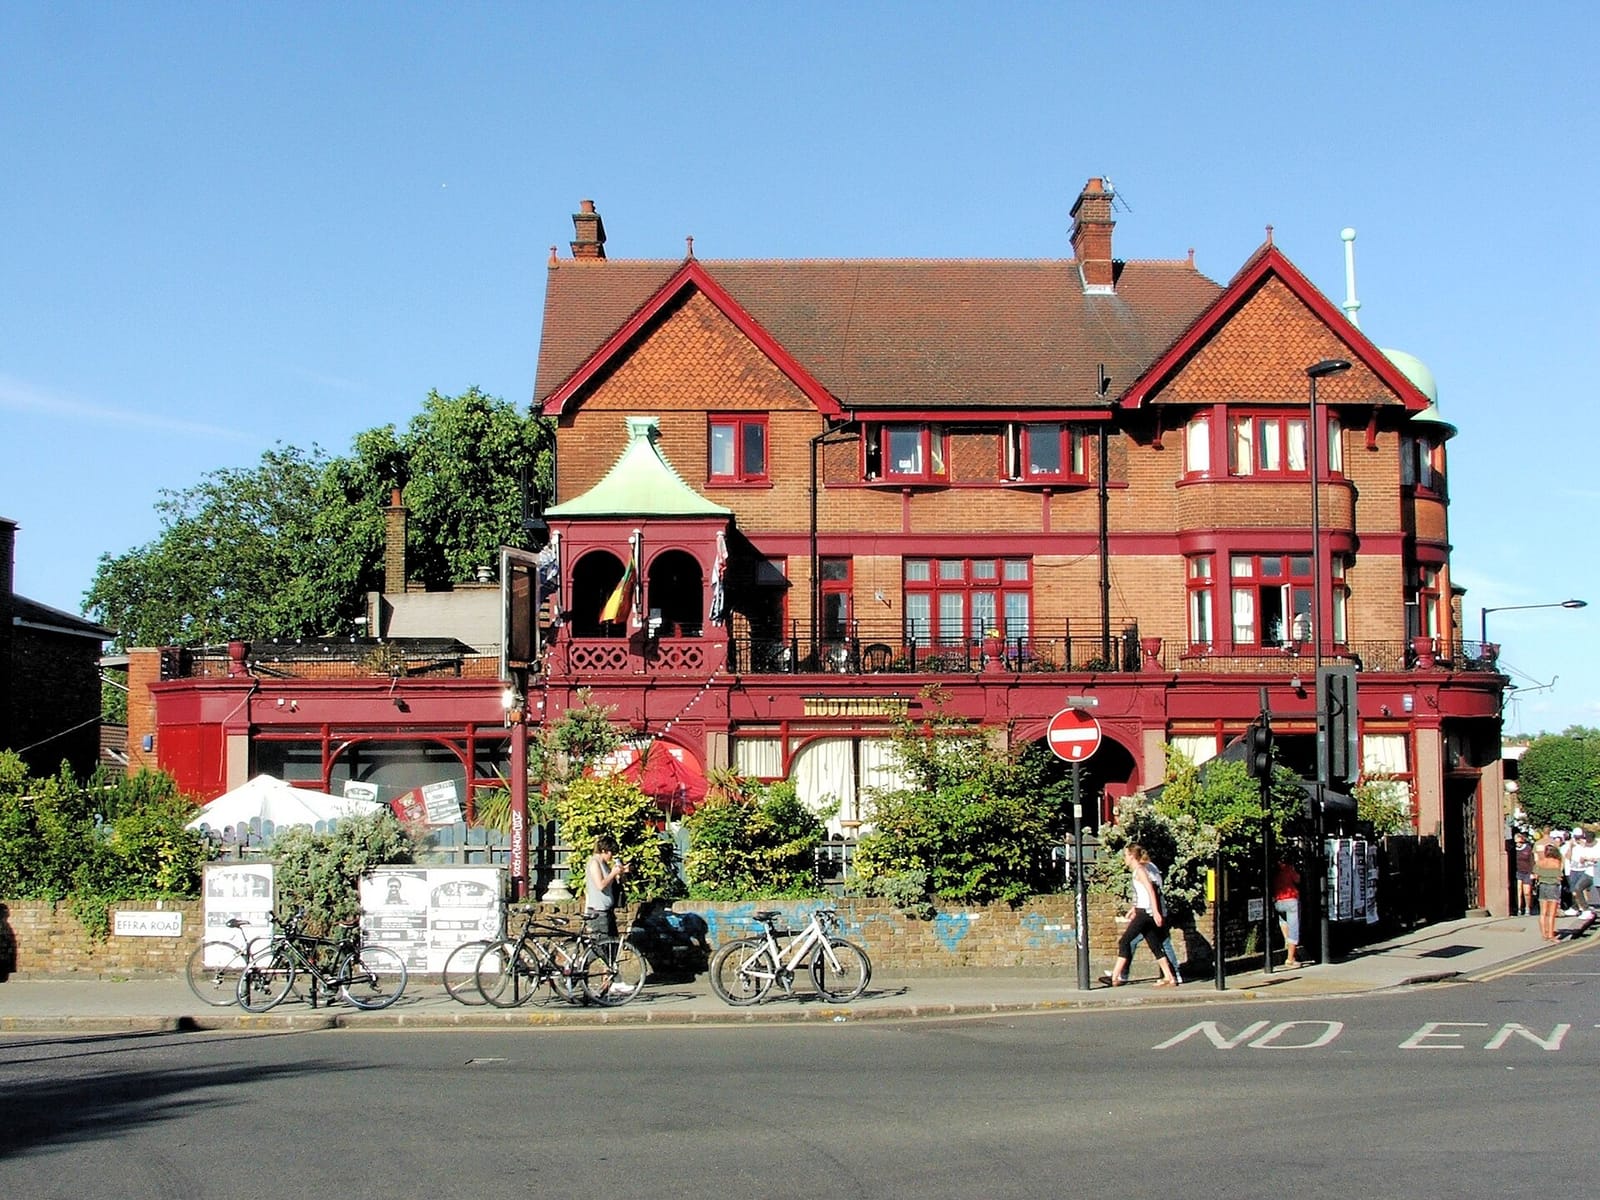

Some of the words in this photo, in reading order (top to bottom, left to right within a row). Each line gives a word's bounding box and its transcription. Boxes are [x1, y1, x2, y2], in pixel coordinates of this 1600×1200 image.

[117, 920, 147, 930] EFFRA
[150, 921, 180, 931] ROAD
[1152, 1020, 1344, 1050] NO
[1398, 1022, 1600, 1050] EN
